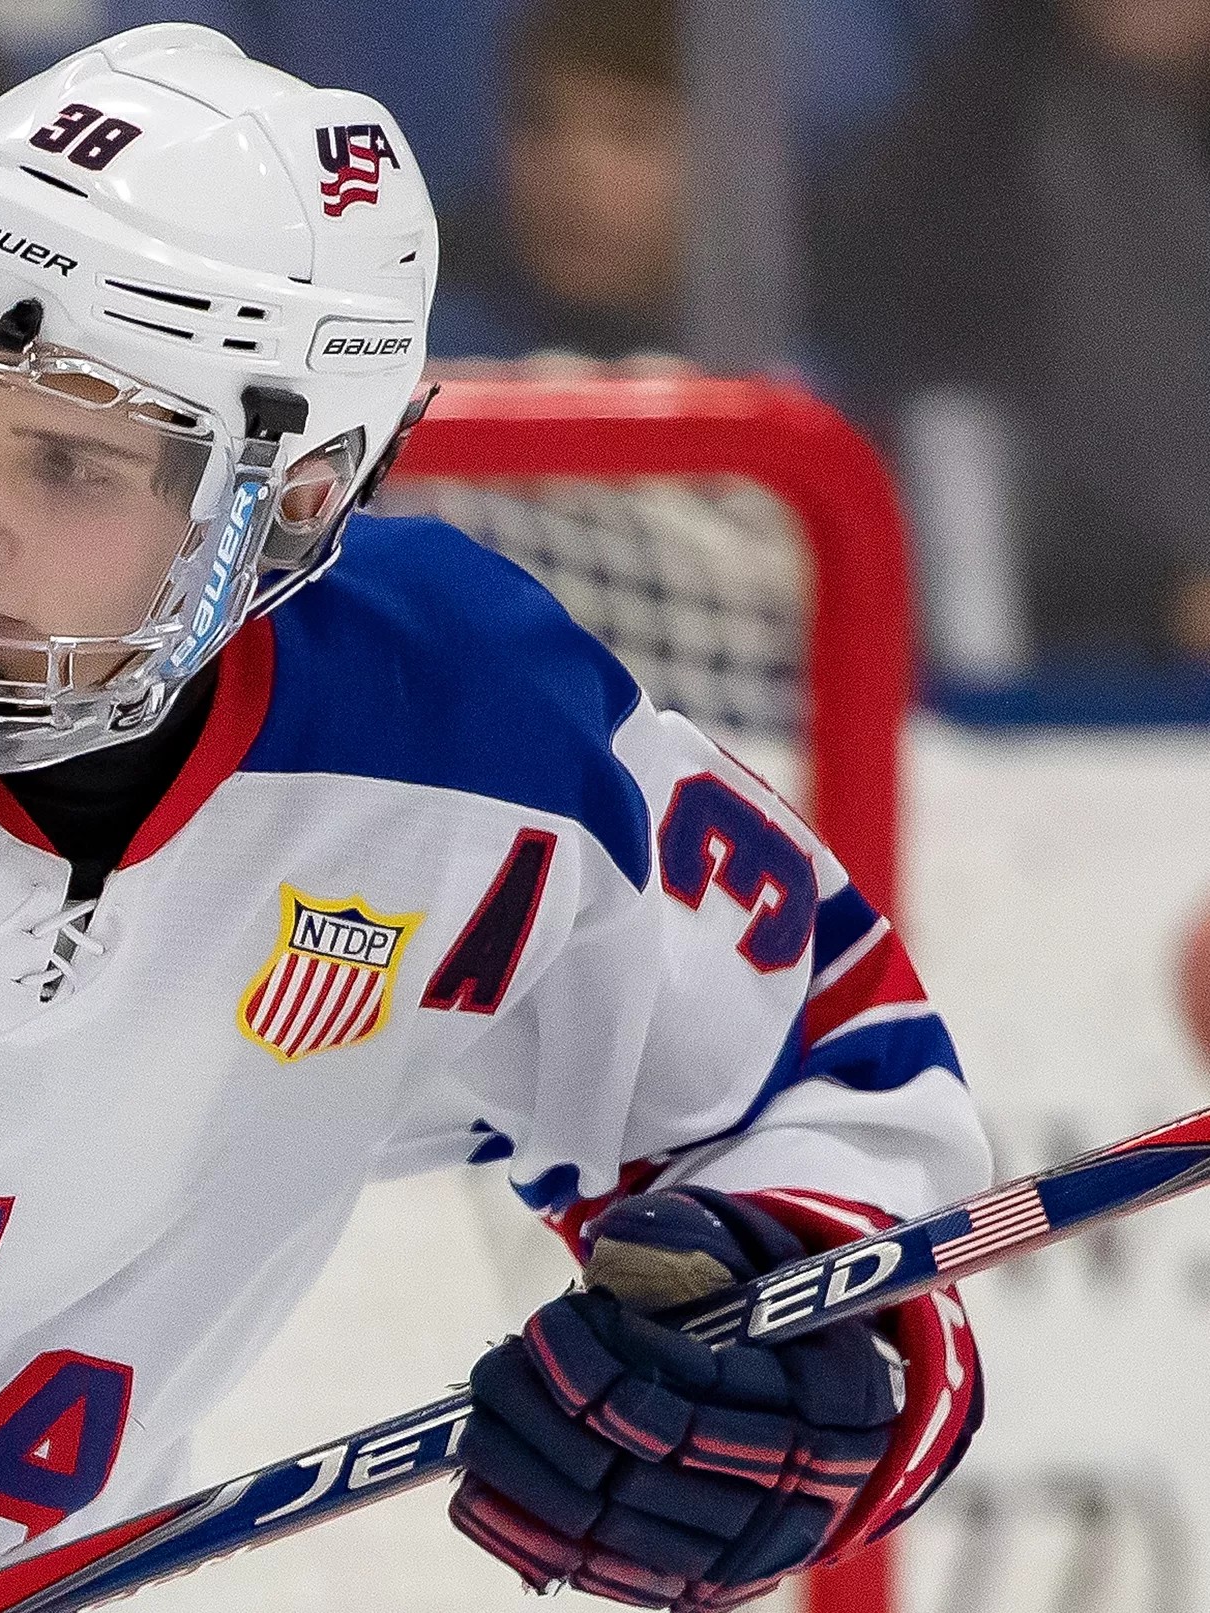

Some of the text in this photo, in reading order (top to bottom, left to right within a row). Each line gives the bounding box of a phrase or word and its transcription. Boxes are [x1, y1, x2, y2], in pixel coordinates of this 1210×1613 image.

[29, 103, 143, 171] 38
[322, 338, 412, 355] BAUER
[657, 770, 821, 976] 3
[299, 914, 389, 961] NTDP
[419, 827, 557, 1016] A
